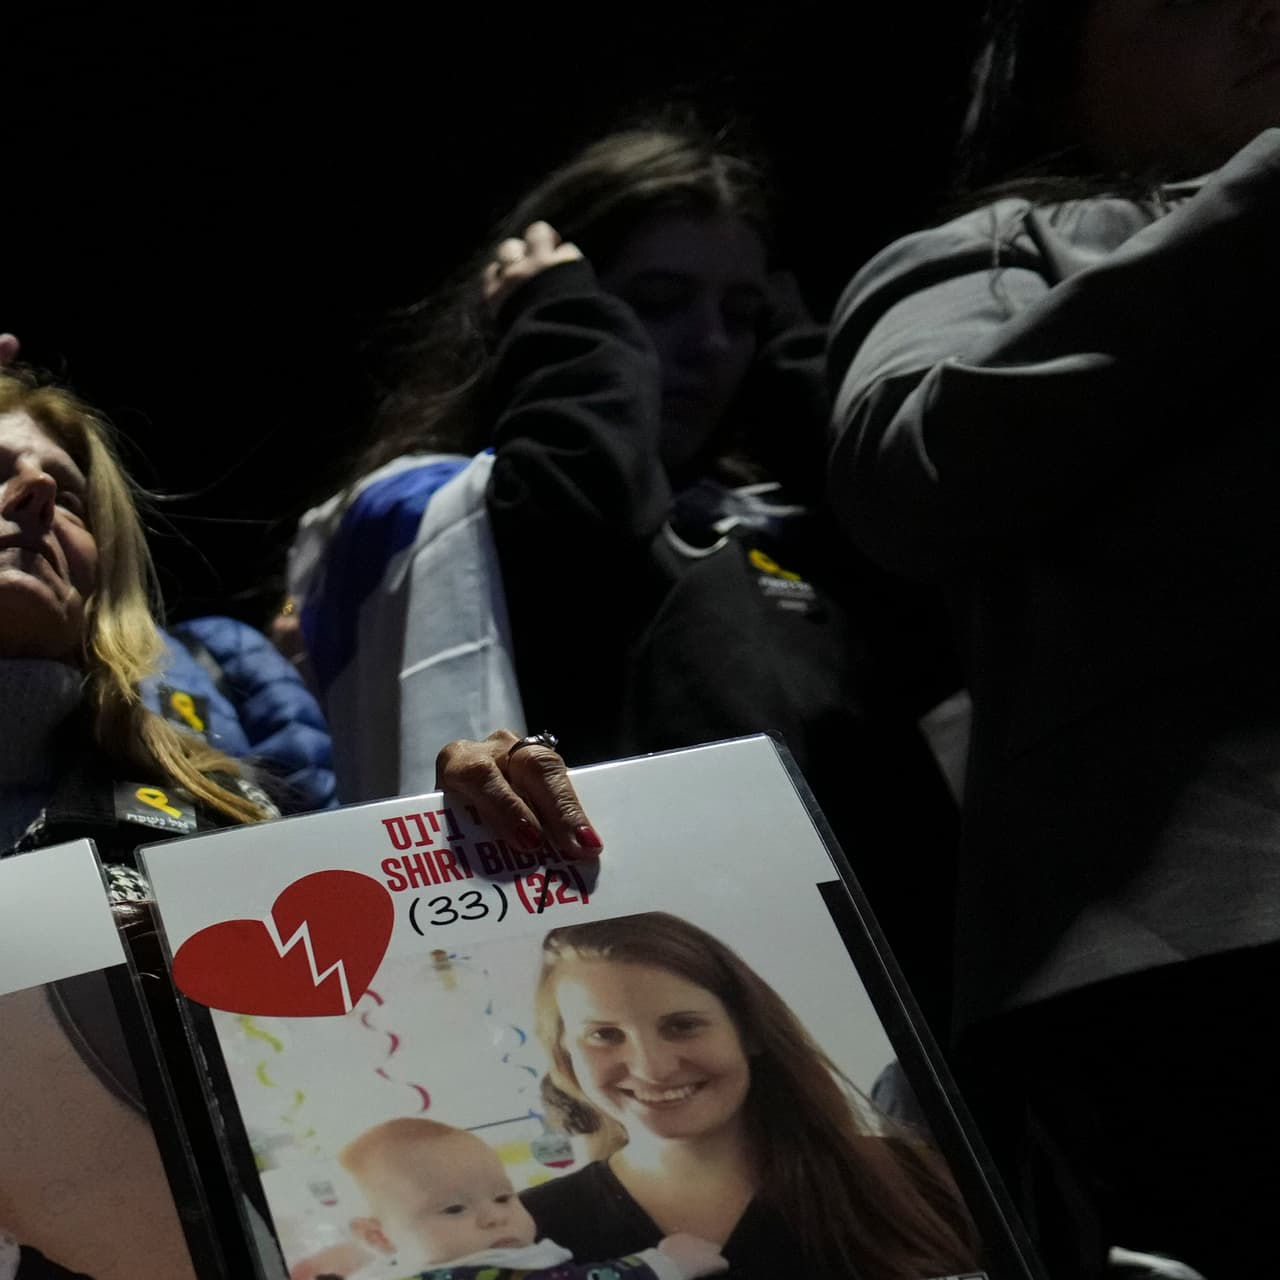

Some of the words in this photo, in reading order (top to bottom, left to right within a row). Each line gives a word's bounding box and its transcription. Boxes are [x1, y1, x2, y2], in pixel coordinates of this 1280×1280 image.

[381, 808, 465, 851] ביבס
[381, 845, 474, 892] SHIRI
[409, 884, 509, 937] (33)
